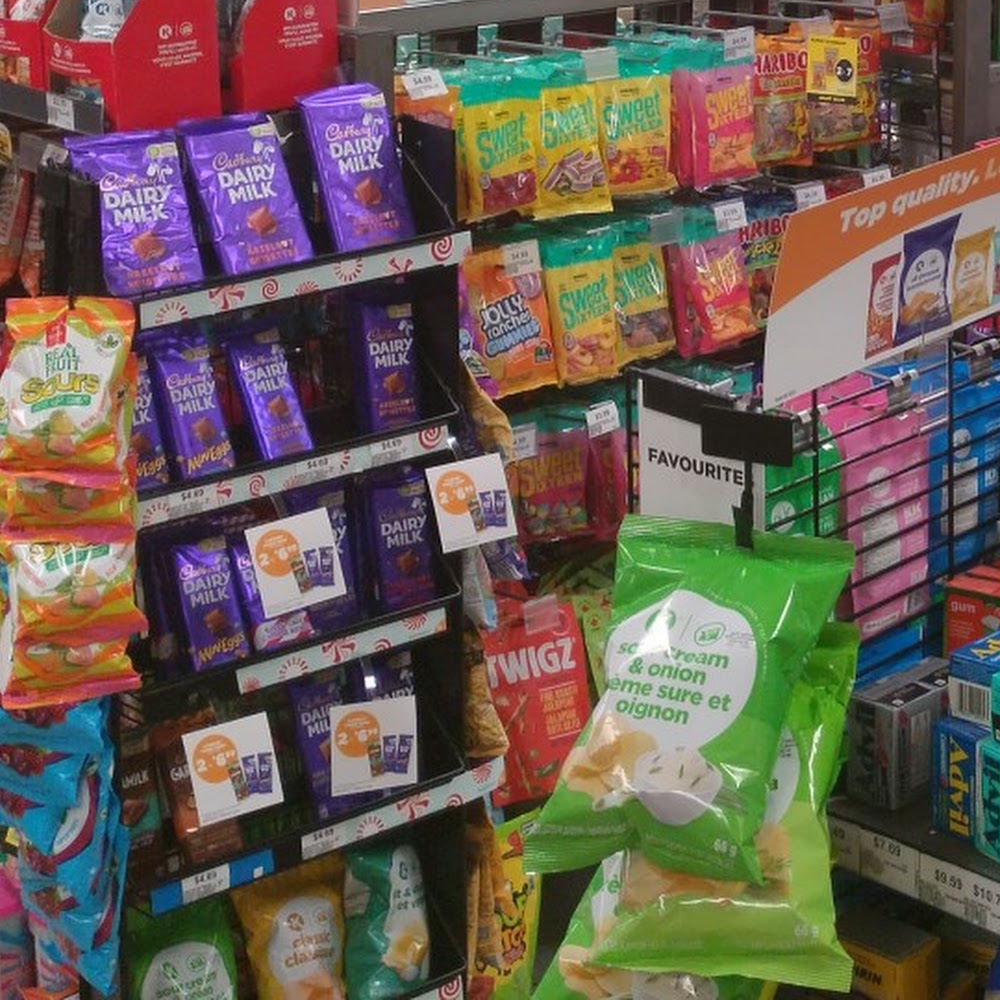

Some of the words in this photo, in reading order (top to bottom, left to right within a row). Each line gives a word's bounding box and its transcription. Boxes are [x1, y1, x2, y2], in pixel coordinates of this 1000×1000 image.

[754, 51, 808, 75] HARIBO
[328, 135, 384, 160] DAIRY
[338, 151, 384, 174] MILK
[217, 162, 276, 188] DAIRY
[103, 183, 172, 211] DAIRY
[226, 181, 276, 204] MILK
[840, 197, 885, 233] Top
[893, 165, 980, 216] quality.
[112, 204, 167, 227] MILK
[481, 294, 523, 330] JOLLY
[368, 338, 413, 358] DAIRY
[488, 319, 539, 356] GUMMIES
[243, 360, 289, 382] DAIRY
[374, 350, 410, 369] MILK
[21, 373, 100, 403] Sours
[169, 379, 217, 403] DAIRY
[251, 372, 289, 394] MILK
[177, 393, 217, 415] MILK
[648, 447, 744, 486] FAVOURITE
[380, 514, 427, 536] DAIRY
[386, 531, 424, 549] MILK
[258, 553, 271, 568] 2
[182, 572, 231, 596] DAIRY
[190, 589, 230, 608] MILK
[951, 599, 976, 615] gum
[487, 637, 576, 688] TWIGZ
[668, 645, 729, 670] cream
[628, 657, 644, 675] &
[647, 661, 706, 685] onion
[657, 680, 704, 706] sure
[708, 687, 732, 712] et
[615, 700, 689, 725] oignon
[307, 720, 331, 738] MIL
[338, 730, 349, 744] 2
[196, 759, 209, 773] 2
[948, 736, 970, 837] Advil
[982, 755, 1000, 857] Advil
